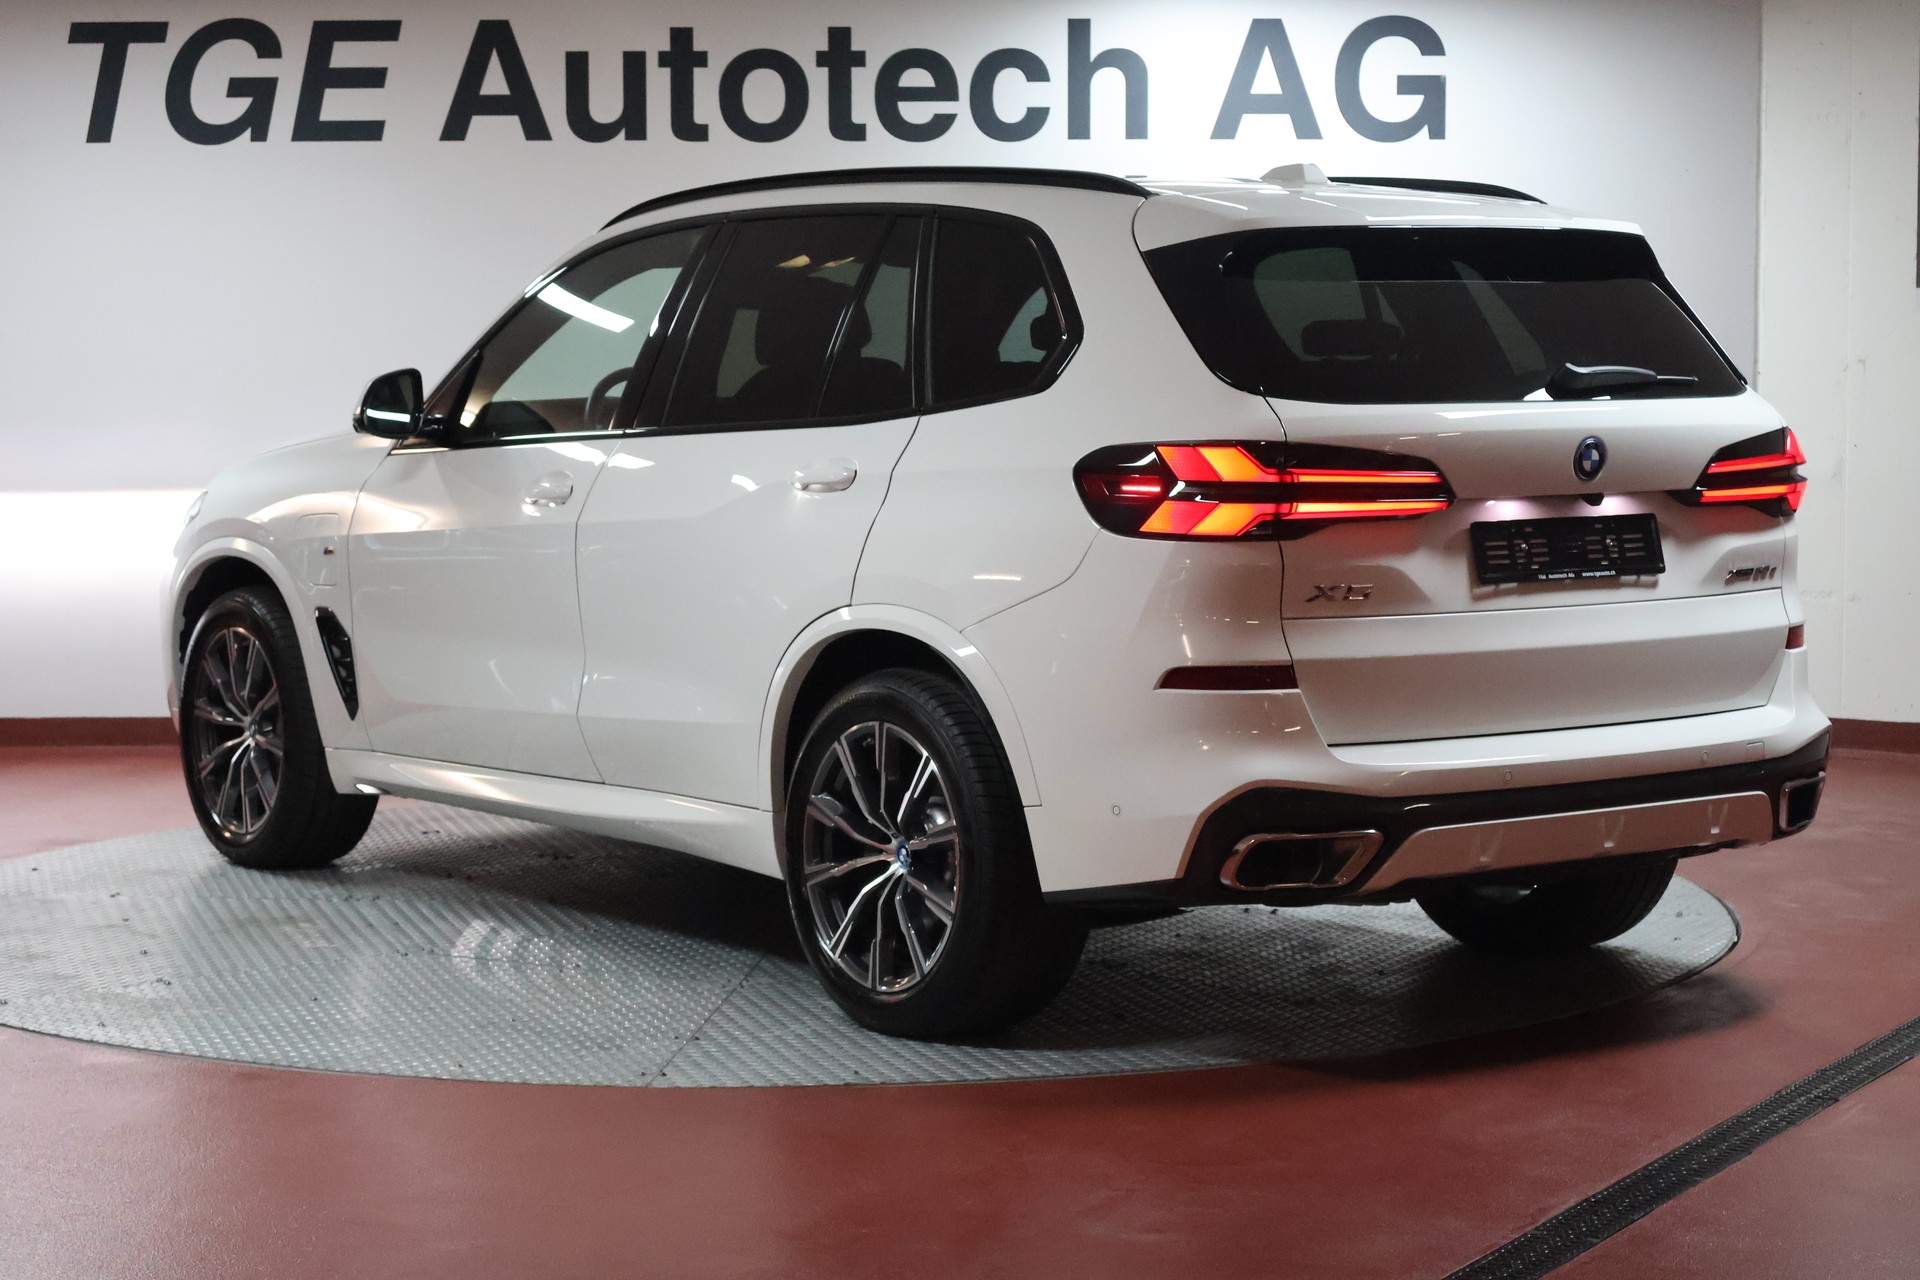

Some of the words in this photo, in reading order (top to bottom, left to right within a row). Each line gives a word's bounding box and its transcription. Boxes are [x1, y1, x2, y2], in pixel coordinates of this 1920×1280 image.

[67, 18, 402, 145] TGE
[438, 18, 1149, 143] Autotech
[1209, 15, 1447, 143] AG
